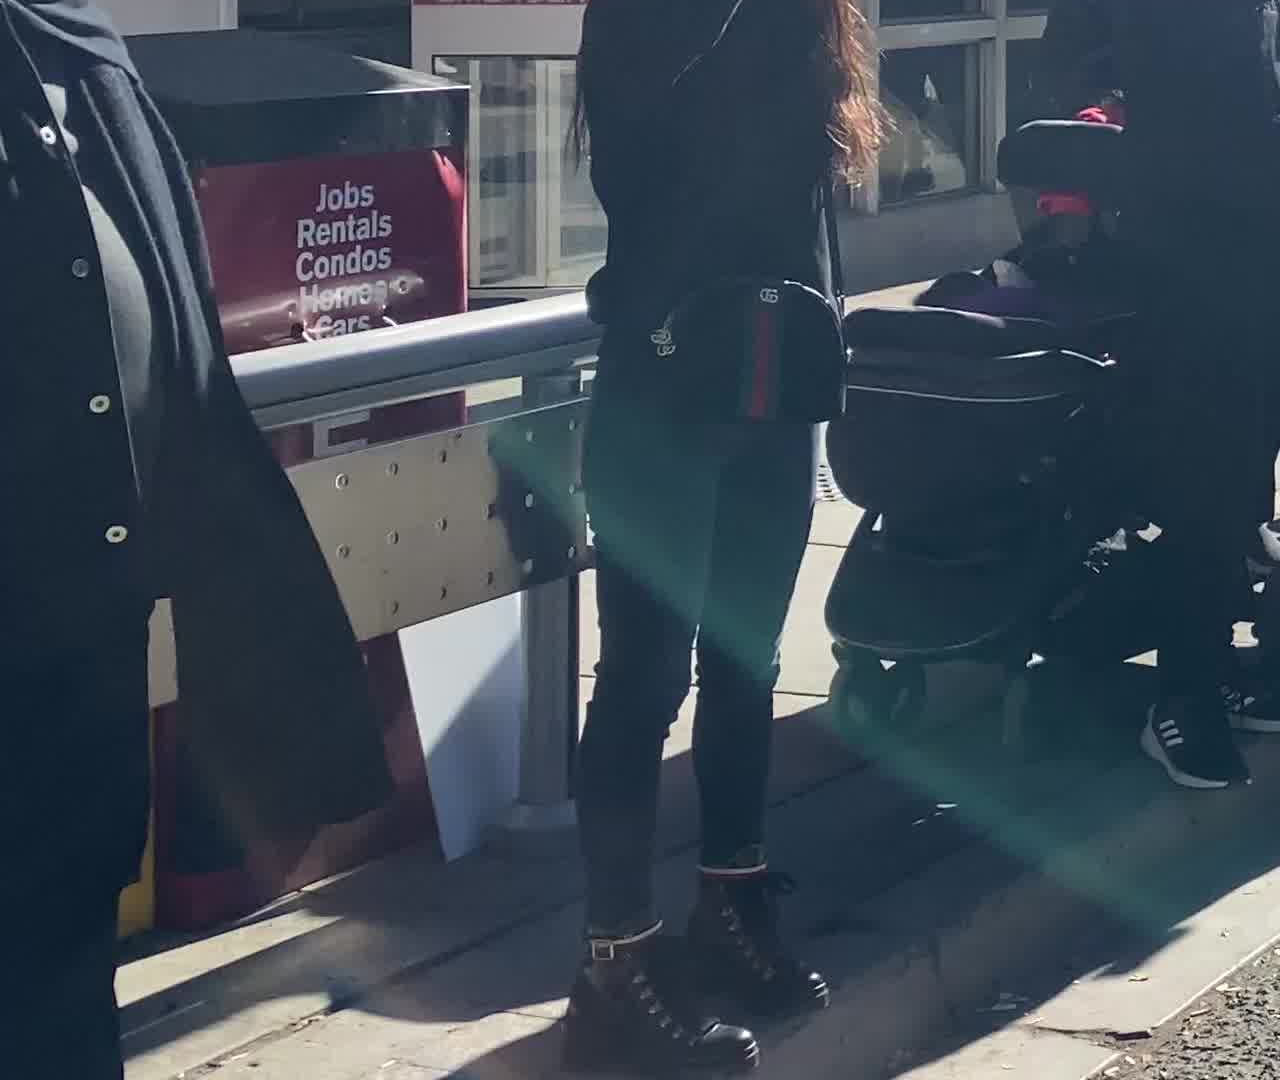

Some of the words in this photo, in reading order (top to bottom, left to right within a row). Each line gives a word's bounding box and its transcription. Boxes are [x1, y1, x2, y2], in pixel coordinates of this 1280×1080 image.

[316, 181, 374, 213] Jobs
[297, 209, 392, 249] Rentals
[296, 244, 392, 282] Condos
